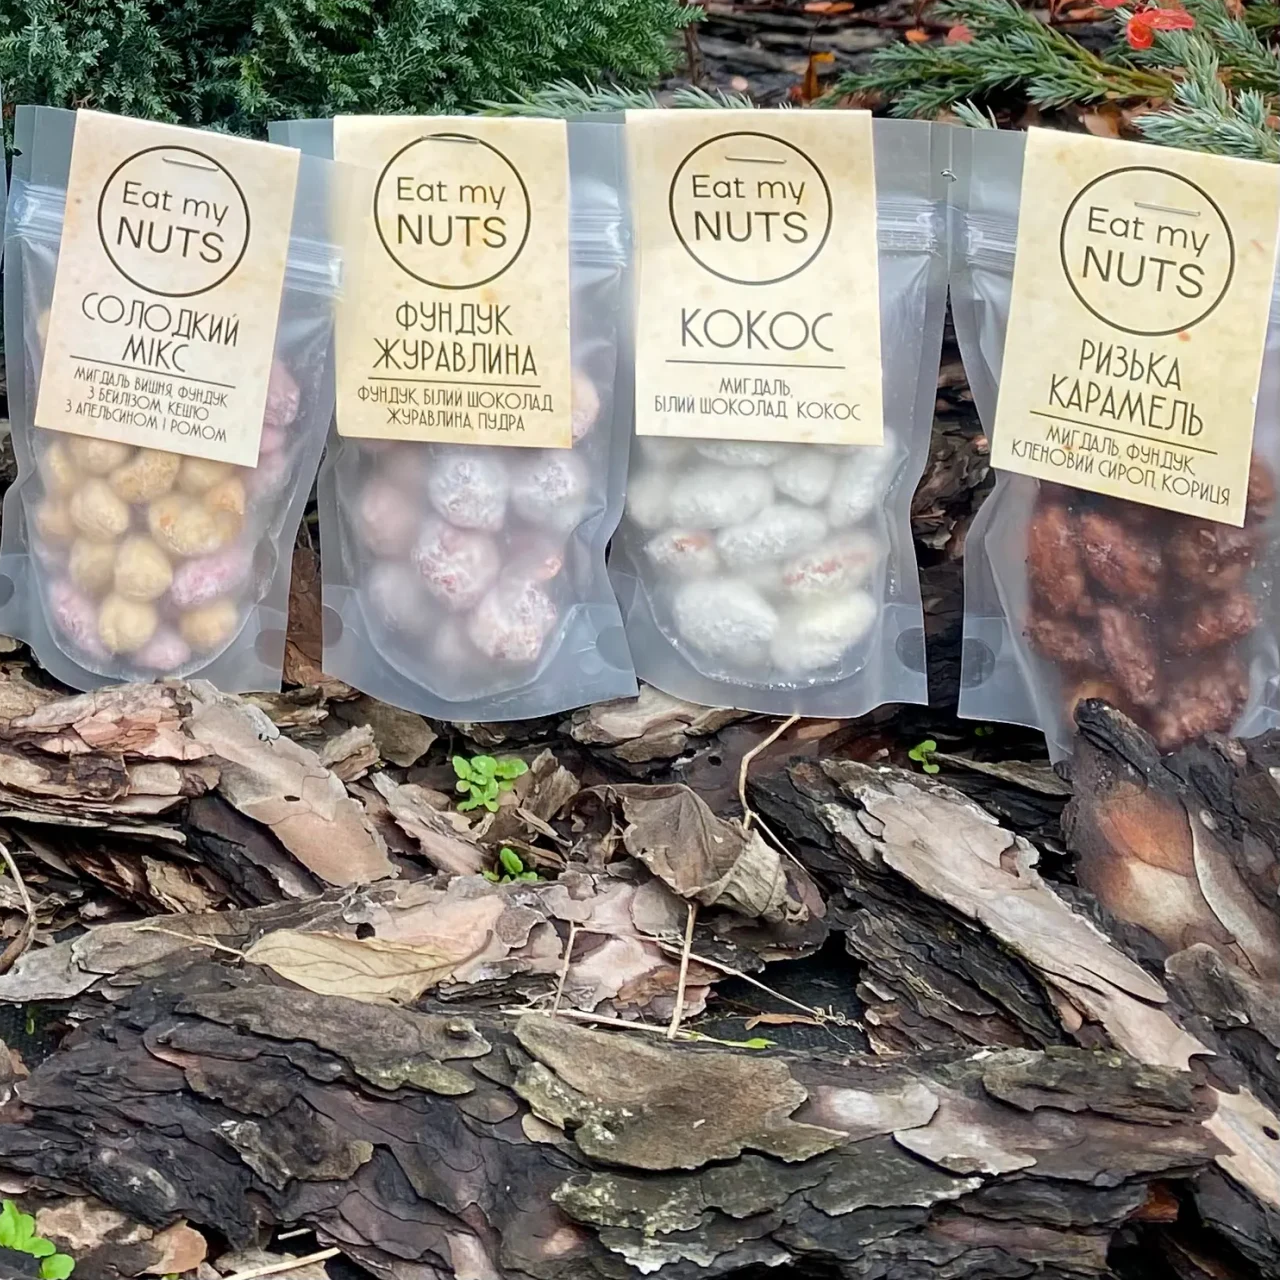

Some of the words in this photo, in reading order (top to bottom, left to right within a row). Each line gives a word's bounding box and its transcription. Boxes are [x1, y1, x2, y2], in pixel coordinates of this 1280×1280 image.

[122, 180, 173, 211] Eat
[183, 197, 229, 226] my
[396, 176, 448, 202] Eat
[459, 184, 506, 210] my
[692, 174, 744, 199] Eat
[757, 180, 805, 205] my
[117, 216, 225, 263] NUTS
[397, 214, 507, 248] NUTS
[695, 211, 808, 243] NUTS
[1087, 206, 1144, 241] Eat
[1156, 226, 1211, 257] my
[1082, 246, 1206, 299] NUTS
[82, 292, 241, 347] СОЛОДКИЙ
[396, 301, 513, 336] ФУНДУК
[681, 308, 834, 352] КОКОС
[122, 334, 189, 373] МІКС
[372, 338, 537, 376] ЖУРАВЛИНА
[1078, 338, 1182, 392] РИЗЬКА
[424, 387, 463, 407] БІЛИЙ
[719, 378, 794, 398] МИГДАЛЬ,
[1048, 373, 1204, 437] КАРАМЕЛЬ
[75, 402, 158, 430] АПЕЛЬСИНОМ
[171, 419, 227, 442] РОМОМ
[478, 413, 525, 431] ПУДРА
[654, 394, 695, 413] БІЛИЙ
[797, 401, 861, 421] КОКОС
[1046, 425, 1122, 459] МИГДАЛЬ,
[1011, 439, 1094, 474] КЛЕНОВИЙ
[1162, 474, 1230, 507] КОРИЦЯ
